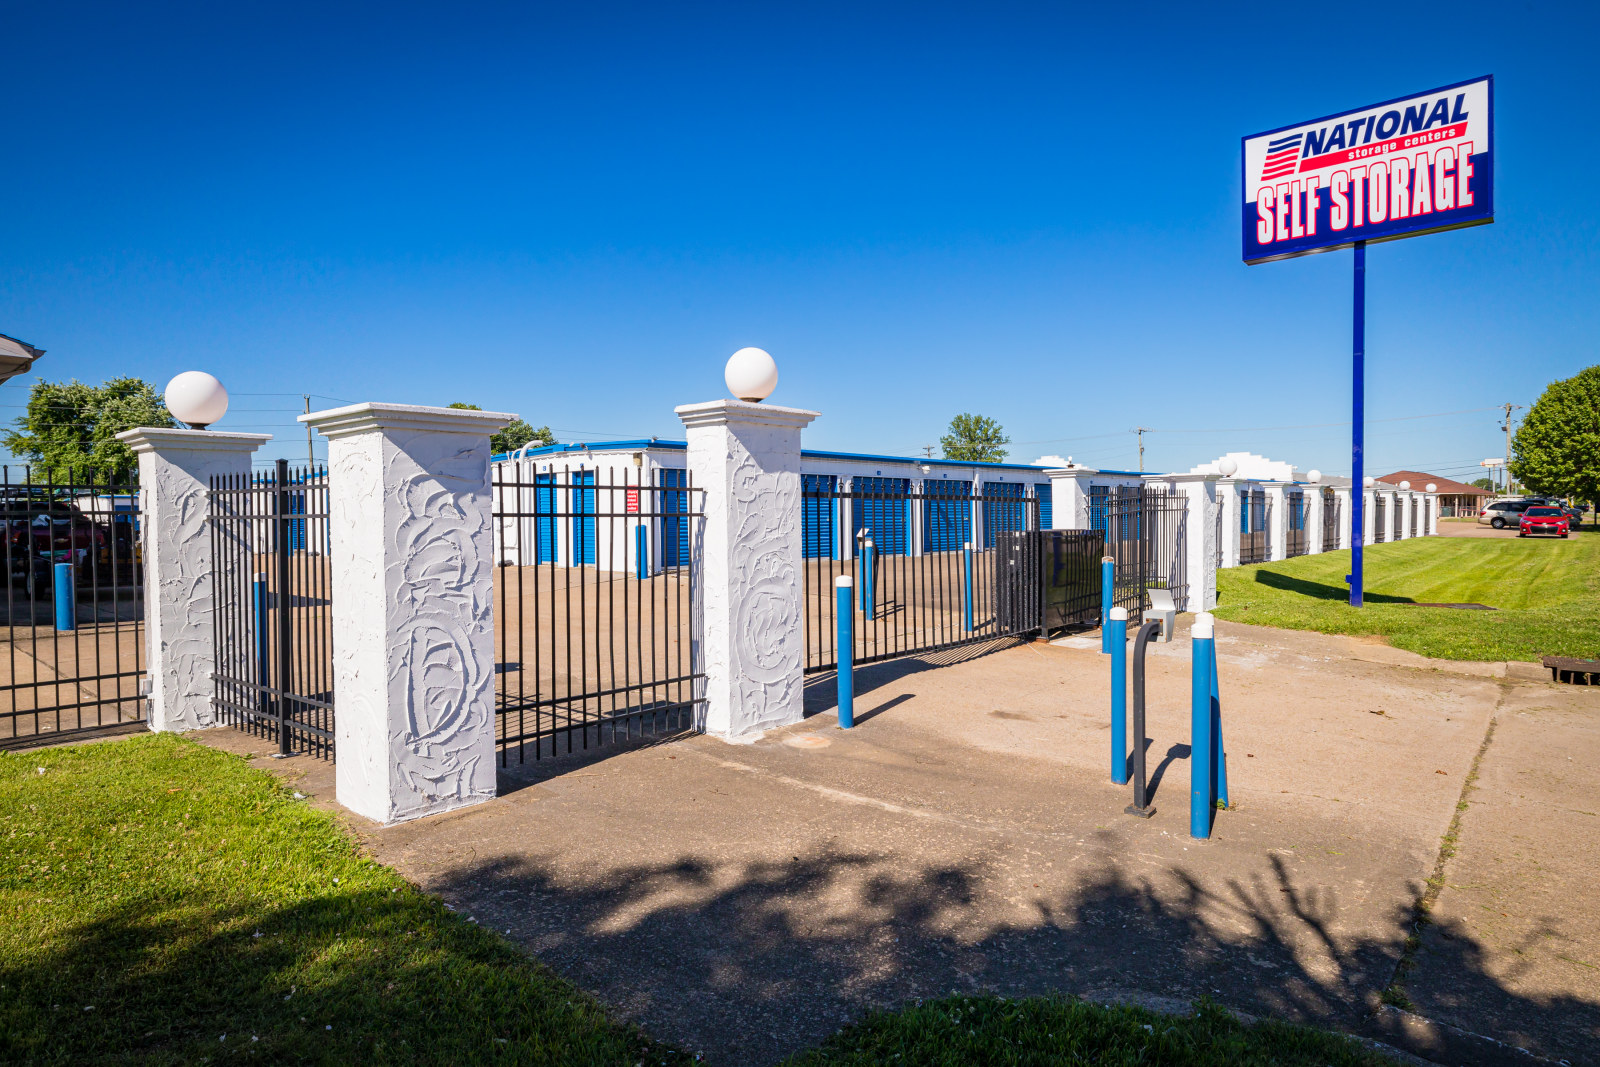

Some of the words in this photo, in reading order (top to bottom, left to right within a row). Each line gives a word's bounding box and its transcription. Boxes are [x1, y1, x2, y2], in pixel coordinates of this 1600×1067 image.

[1302, 93, 1469, 158] NATIONAL
[1348, 141, 1396, 160] storage
[1404, 128, 1456, 147] centers
[1257, 175, 1320, 245] SELF
[1330, 141, 1474, 232] STORAGE
